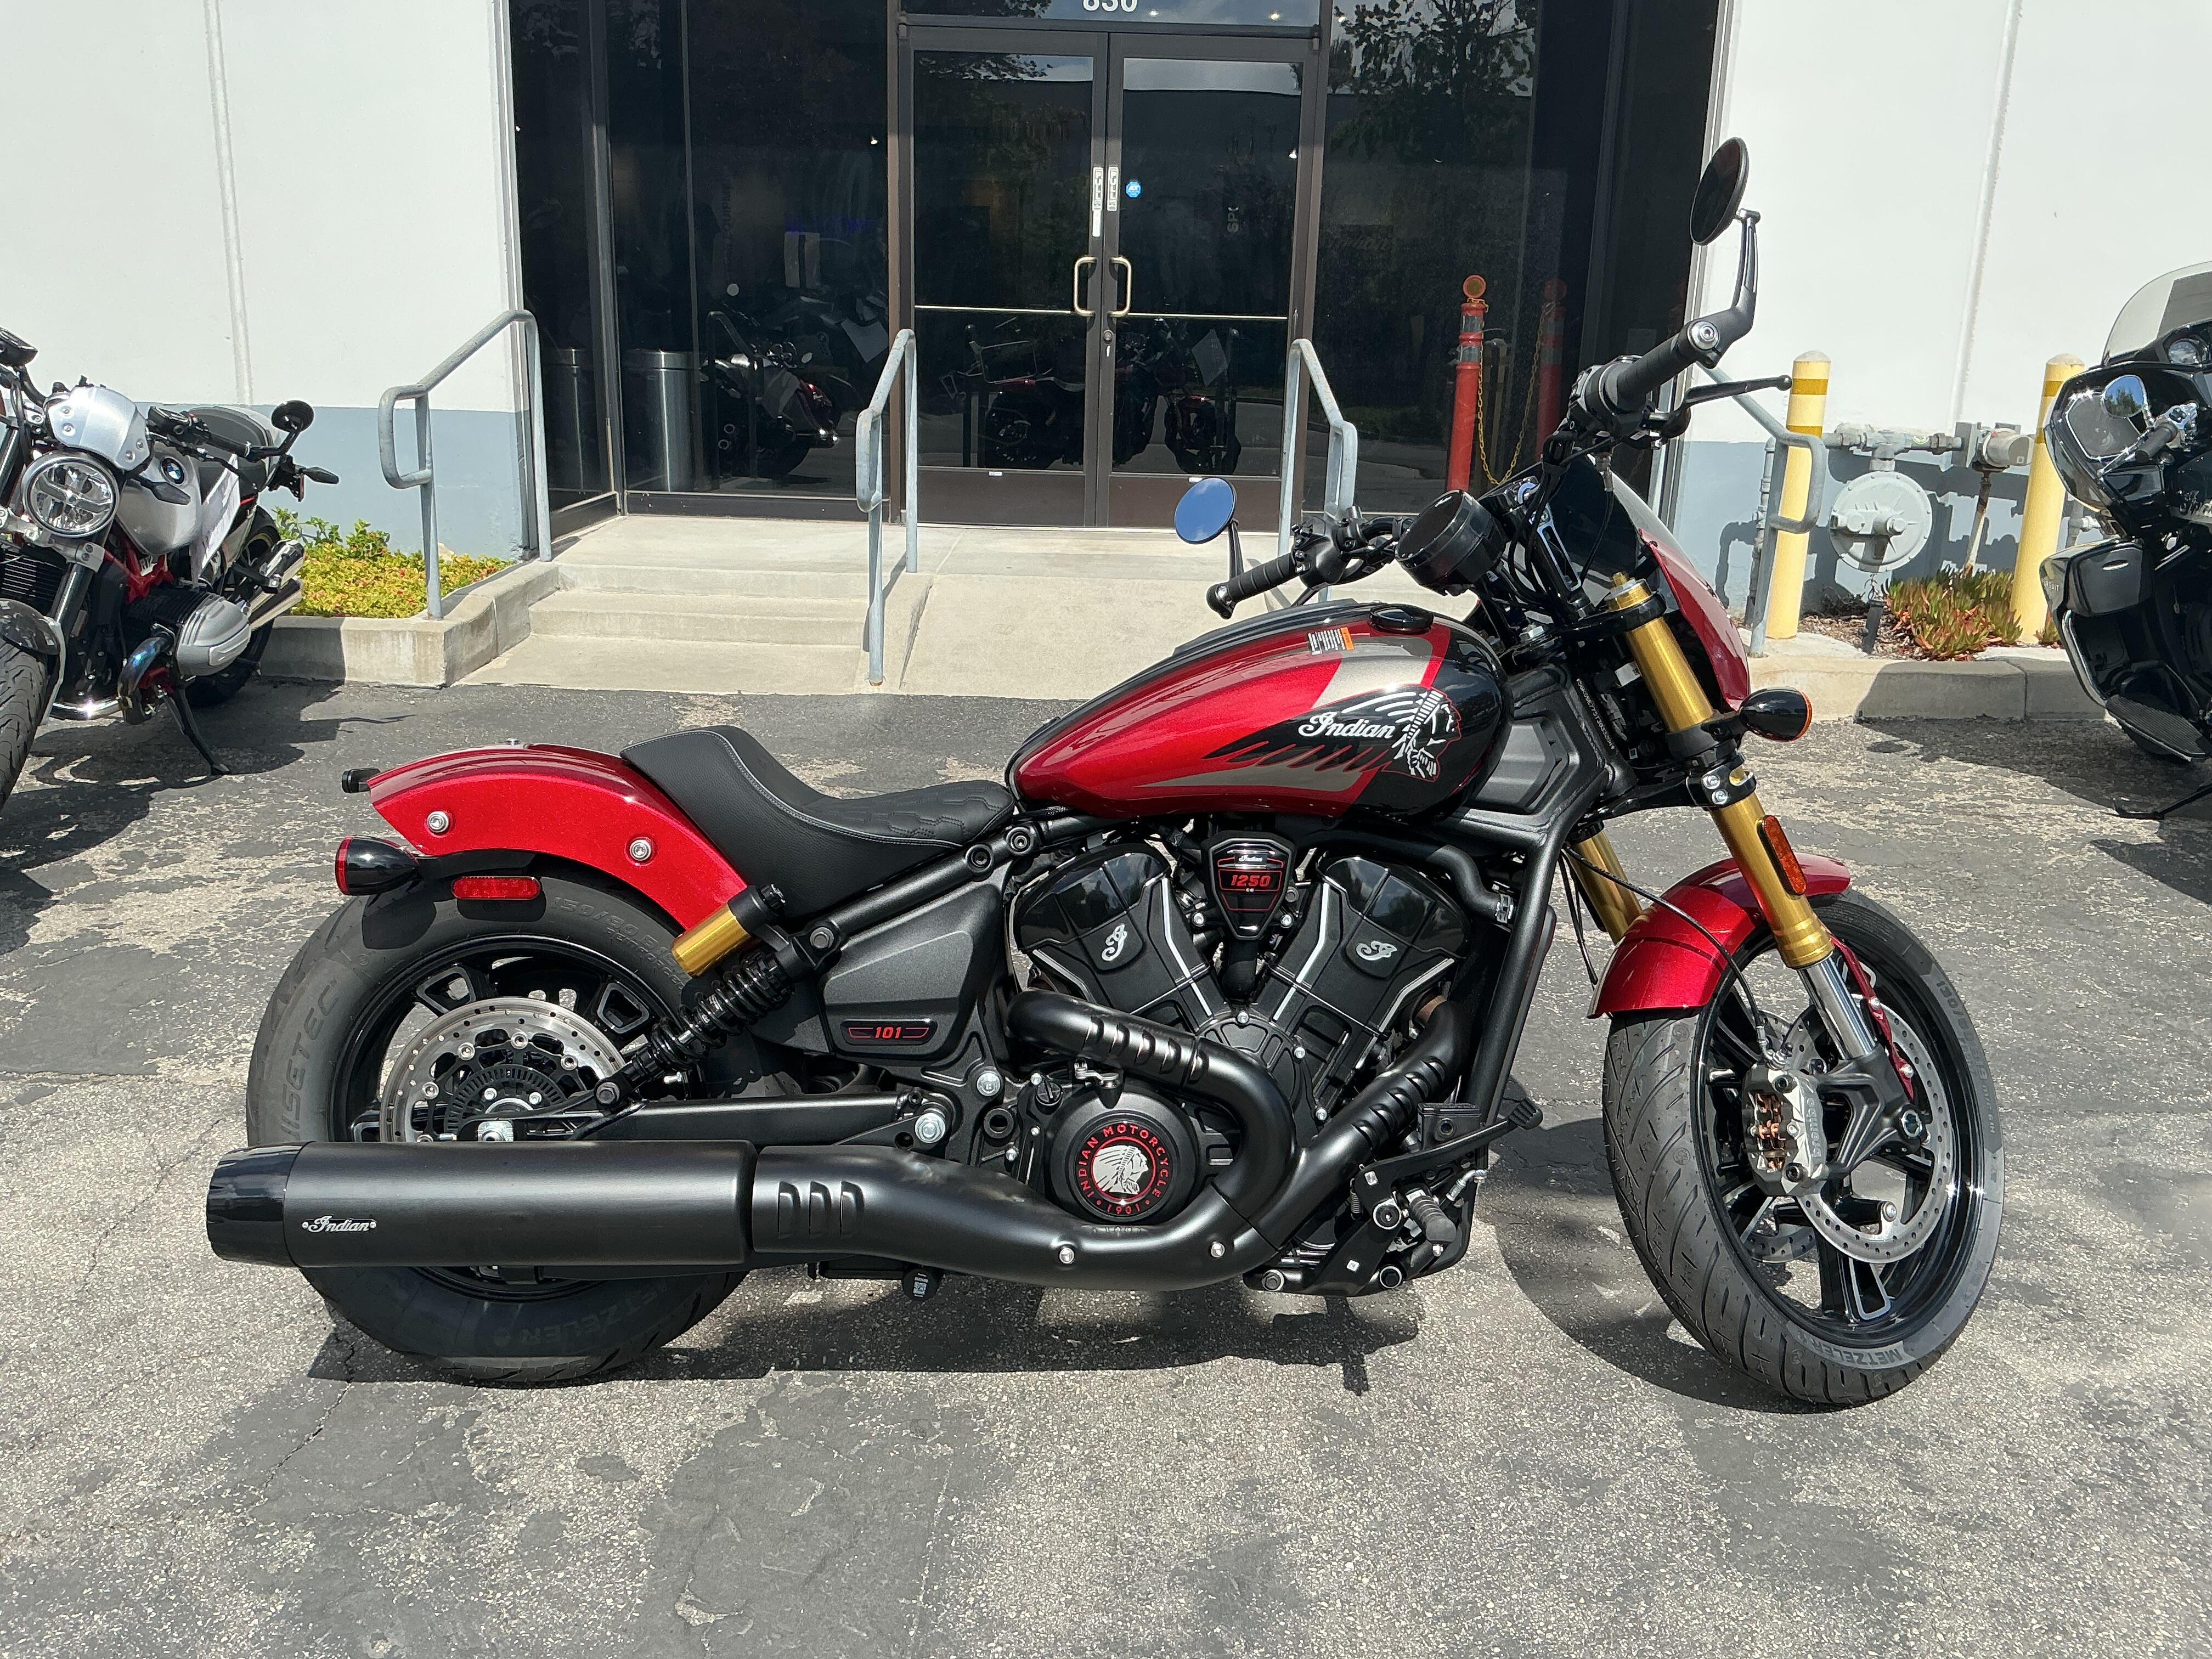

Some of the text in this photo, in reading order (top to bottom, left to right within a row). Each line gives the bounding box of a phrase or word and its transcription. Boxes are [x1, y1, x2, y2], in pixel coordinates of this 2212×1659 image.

[1298, 712, 1396, 739] Indian
[1238, 854, 1263, 862] Indian
[1231, 874, 1271, 887] 1250
[874, 1026, 902, 1039] 101
[1806, 1097, 1822, 1158] brembo
[1078, 1124, 1170, 1198] INDIAN MOTORCYCLE
[1107, 1203, 1142, 1215] 1901
[308, 1216, 369, 1233] Indian
[1811, 1339, 1904, 1367] METZELER
